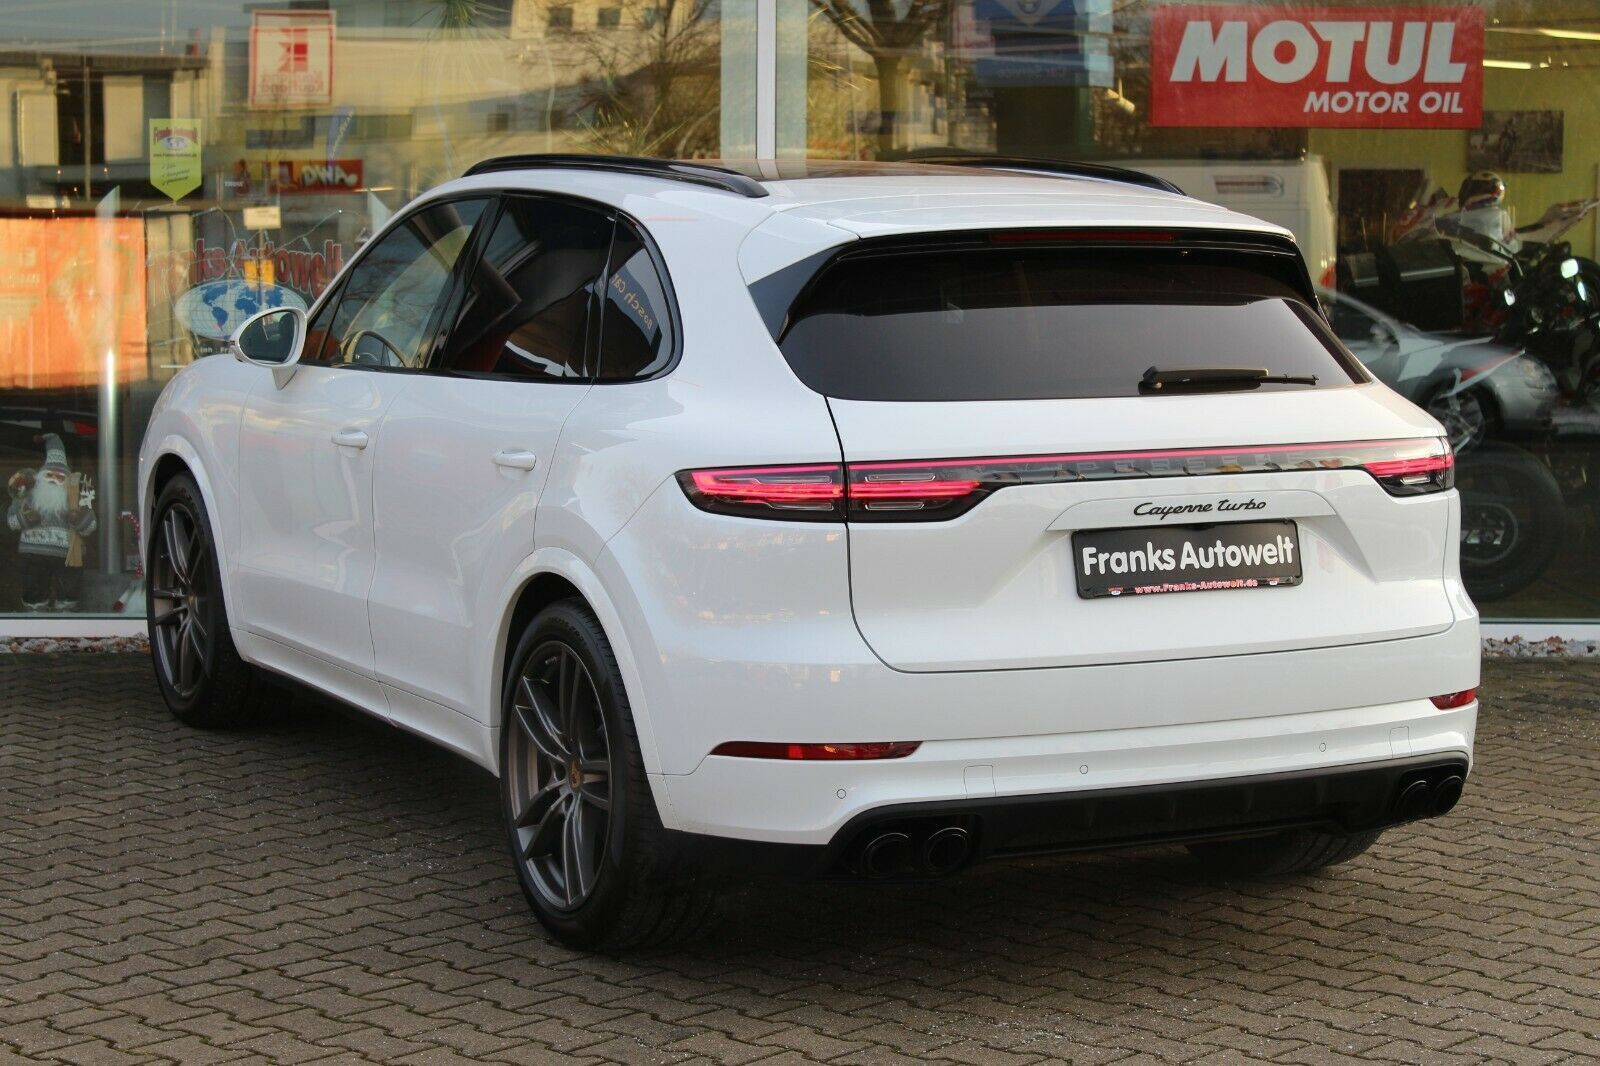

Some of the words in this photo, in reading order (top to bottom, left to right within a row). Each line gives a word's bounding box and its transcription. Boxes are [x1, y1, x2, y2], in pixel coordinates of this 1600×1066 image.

[1169, 19, 1467, 84] MOTUL
[1303, 91, 1409, 113] MOTOR
[1418, 91, 1464, 113] OIL
[1133, 502, 1213, 520] Cayenne
[1082, 541, 1176, 576] Franks
[1180, 534, 1294, 570] Autowelt
[1135, 578, 1258, 594] www.Franks-Autowelt.de
